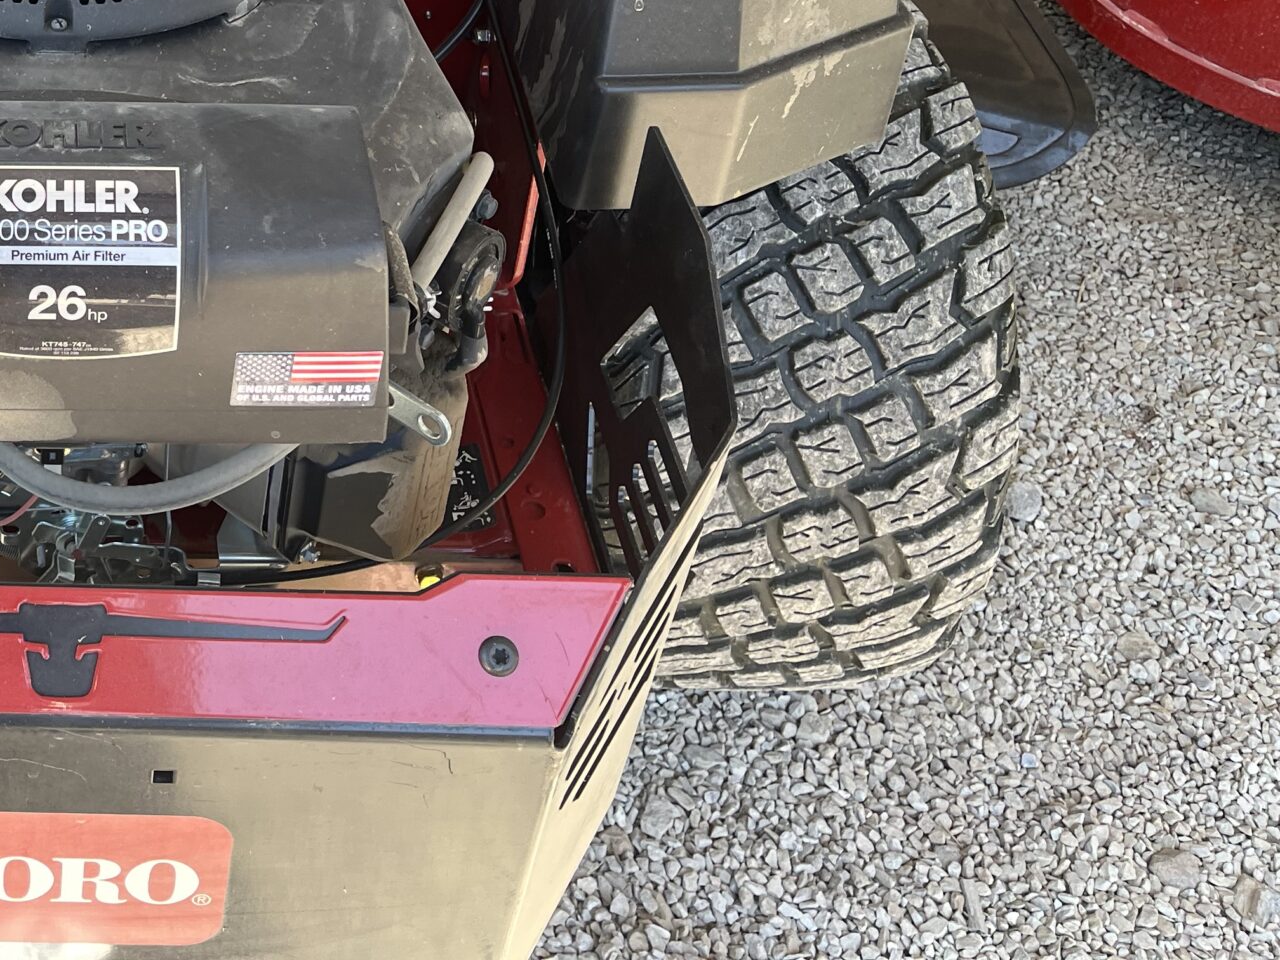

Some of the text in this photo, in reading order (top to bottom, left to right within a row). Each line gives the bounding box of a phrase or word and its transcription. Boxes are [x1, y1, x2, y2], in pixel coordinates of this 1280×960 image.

[34, 219, 106, 242] Series
[111, 220, 168, 242] PRO
[11, 250, 126, 262] Premium Air Filter
[238, 385, 371, 393] ENGINE MADE IN USA
[236, 394, 370, 402] OF U.S. AND GLOBAL PARTS
